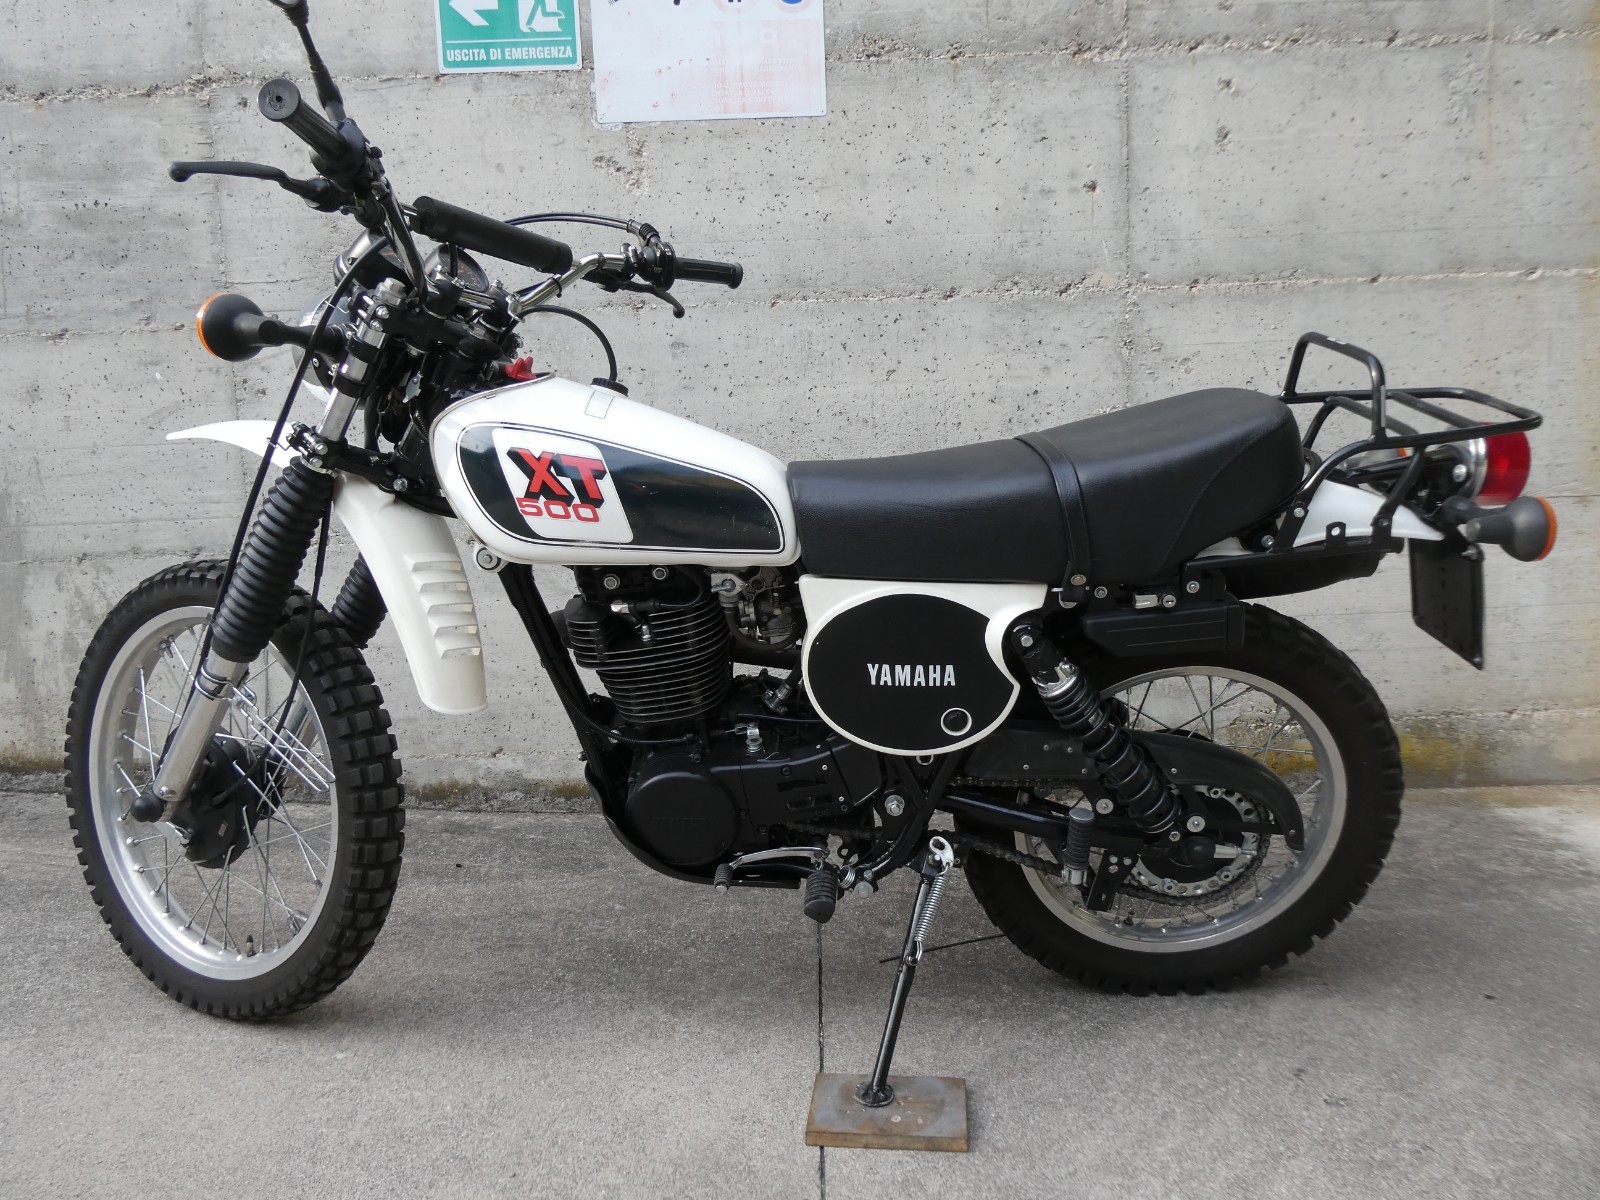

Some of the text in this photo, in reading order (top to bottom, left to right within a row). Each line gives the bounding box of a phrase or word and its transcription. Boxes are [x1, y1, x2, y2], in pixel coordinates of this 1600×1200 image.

[446, 45, 573, 62] USCITA DI EMERGENZA
[506, 446, 608, 509] XT
[515, 497, 600, 523] 500
[866, 663, 956, 687] YAMAHA
